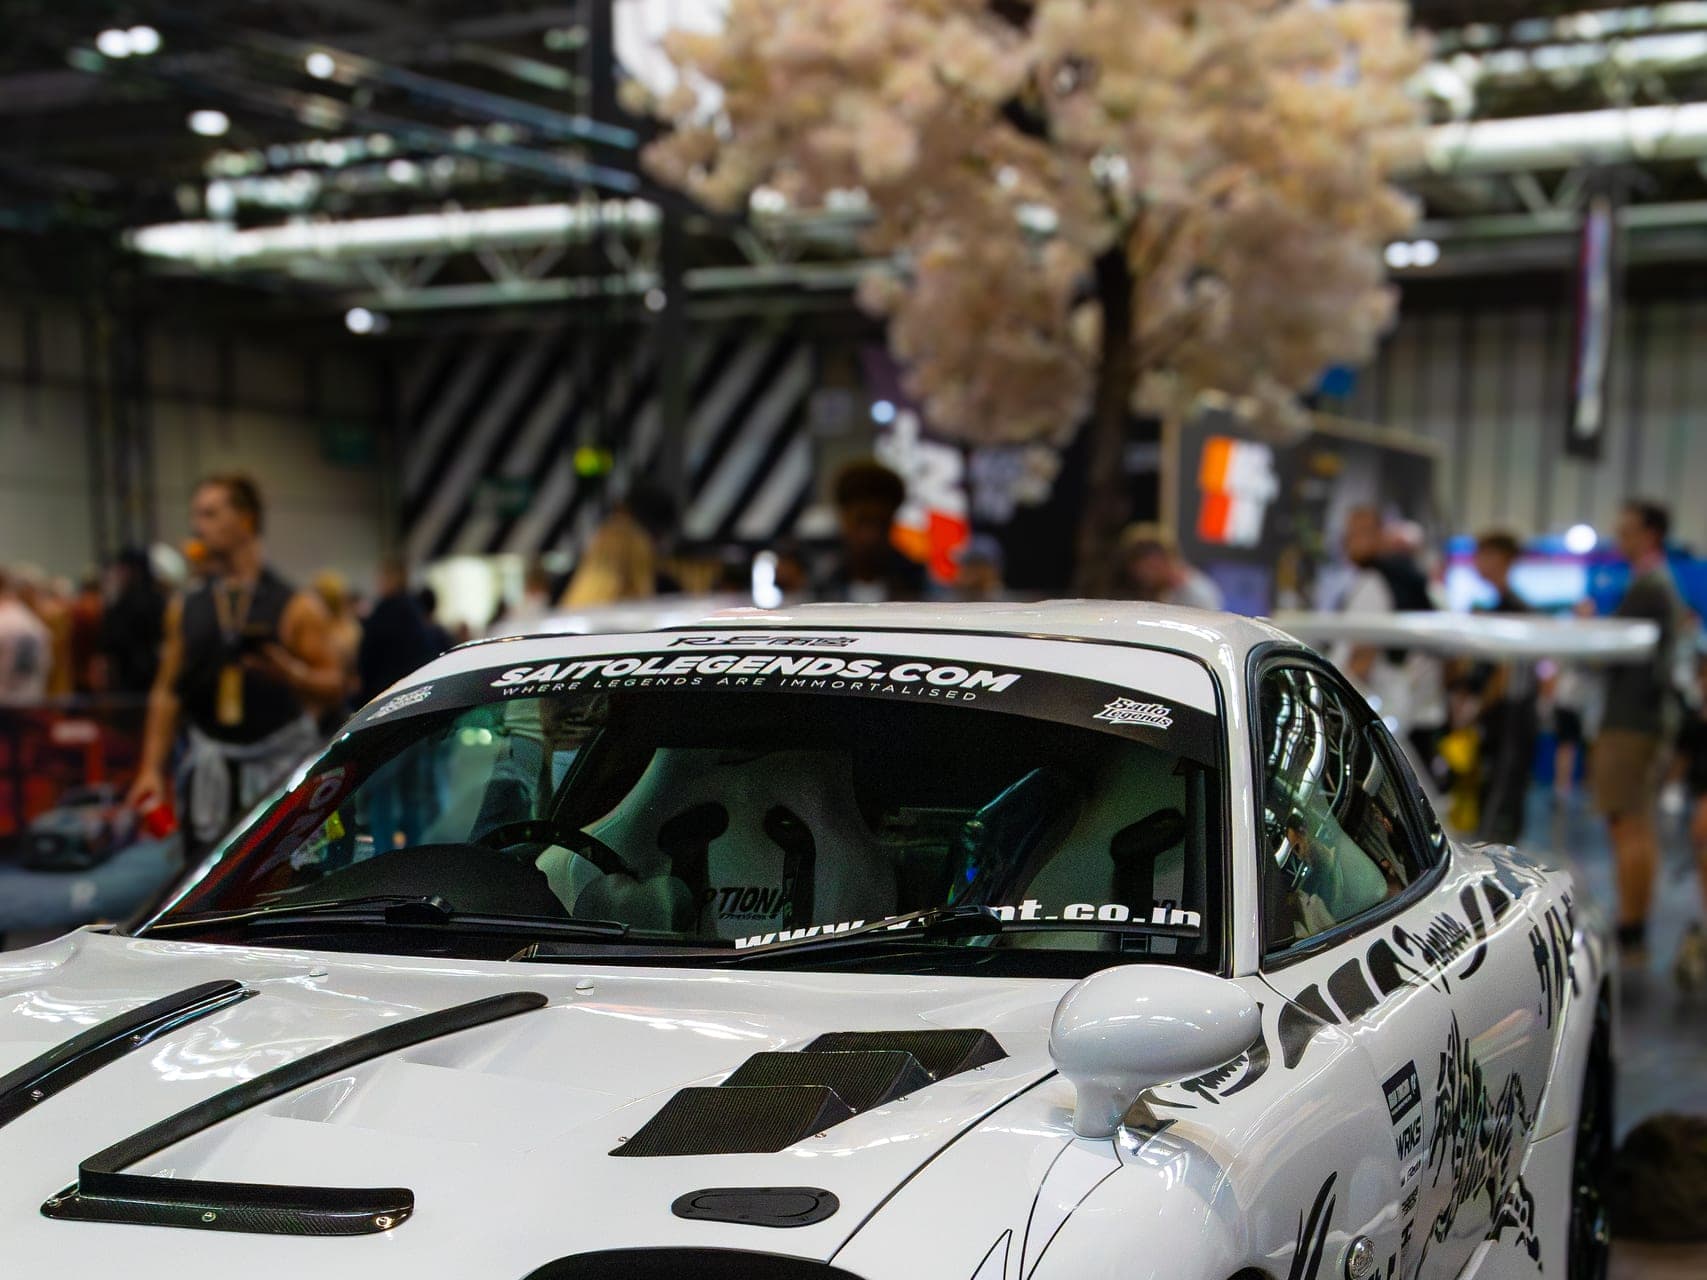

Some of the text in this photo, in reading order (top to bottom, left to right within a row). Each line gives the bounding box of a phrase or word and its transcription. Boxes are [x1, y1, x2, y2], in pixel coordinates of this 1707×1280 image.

[491, 655, 1021, 692] SAITOLEGENDS.COM
[503, 677, 977, 701] WHERE LEGENDS ARE IMMORTALISED
